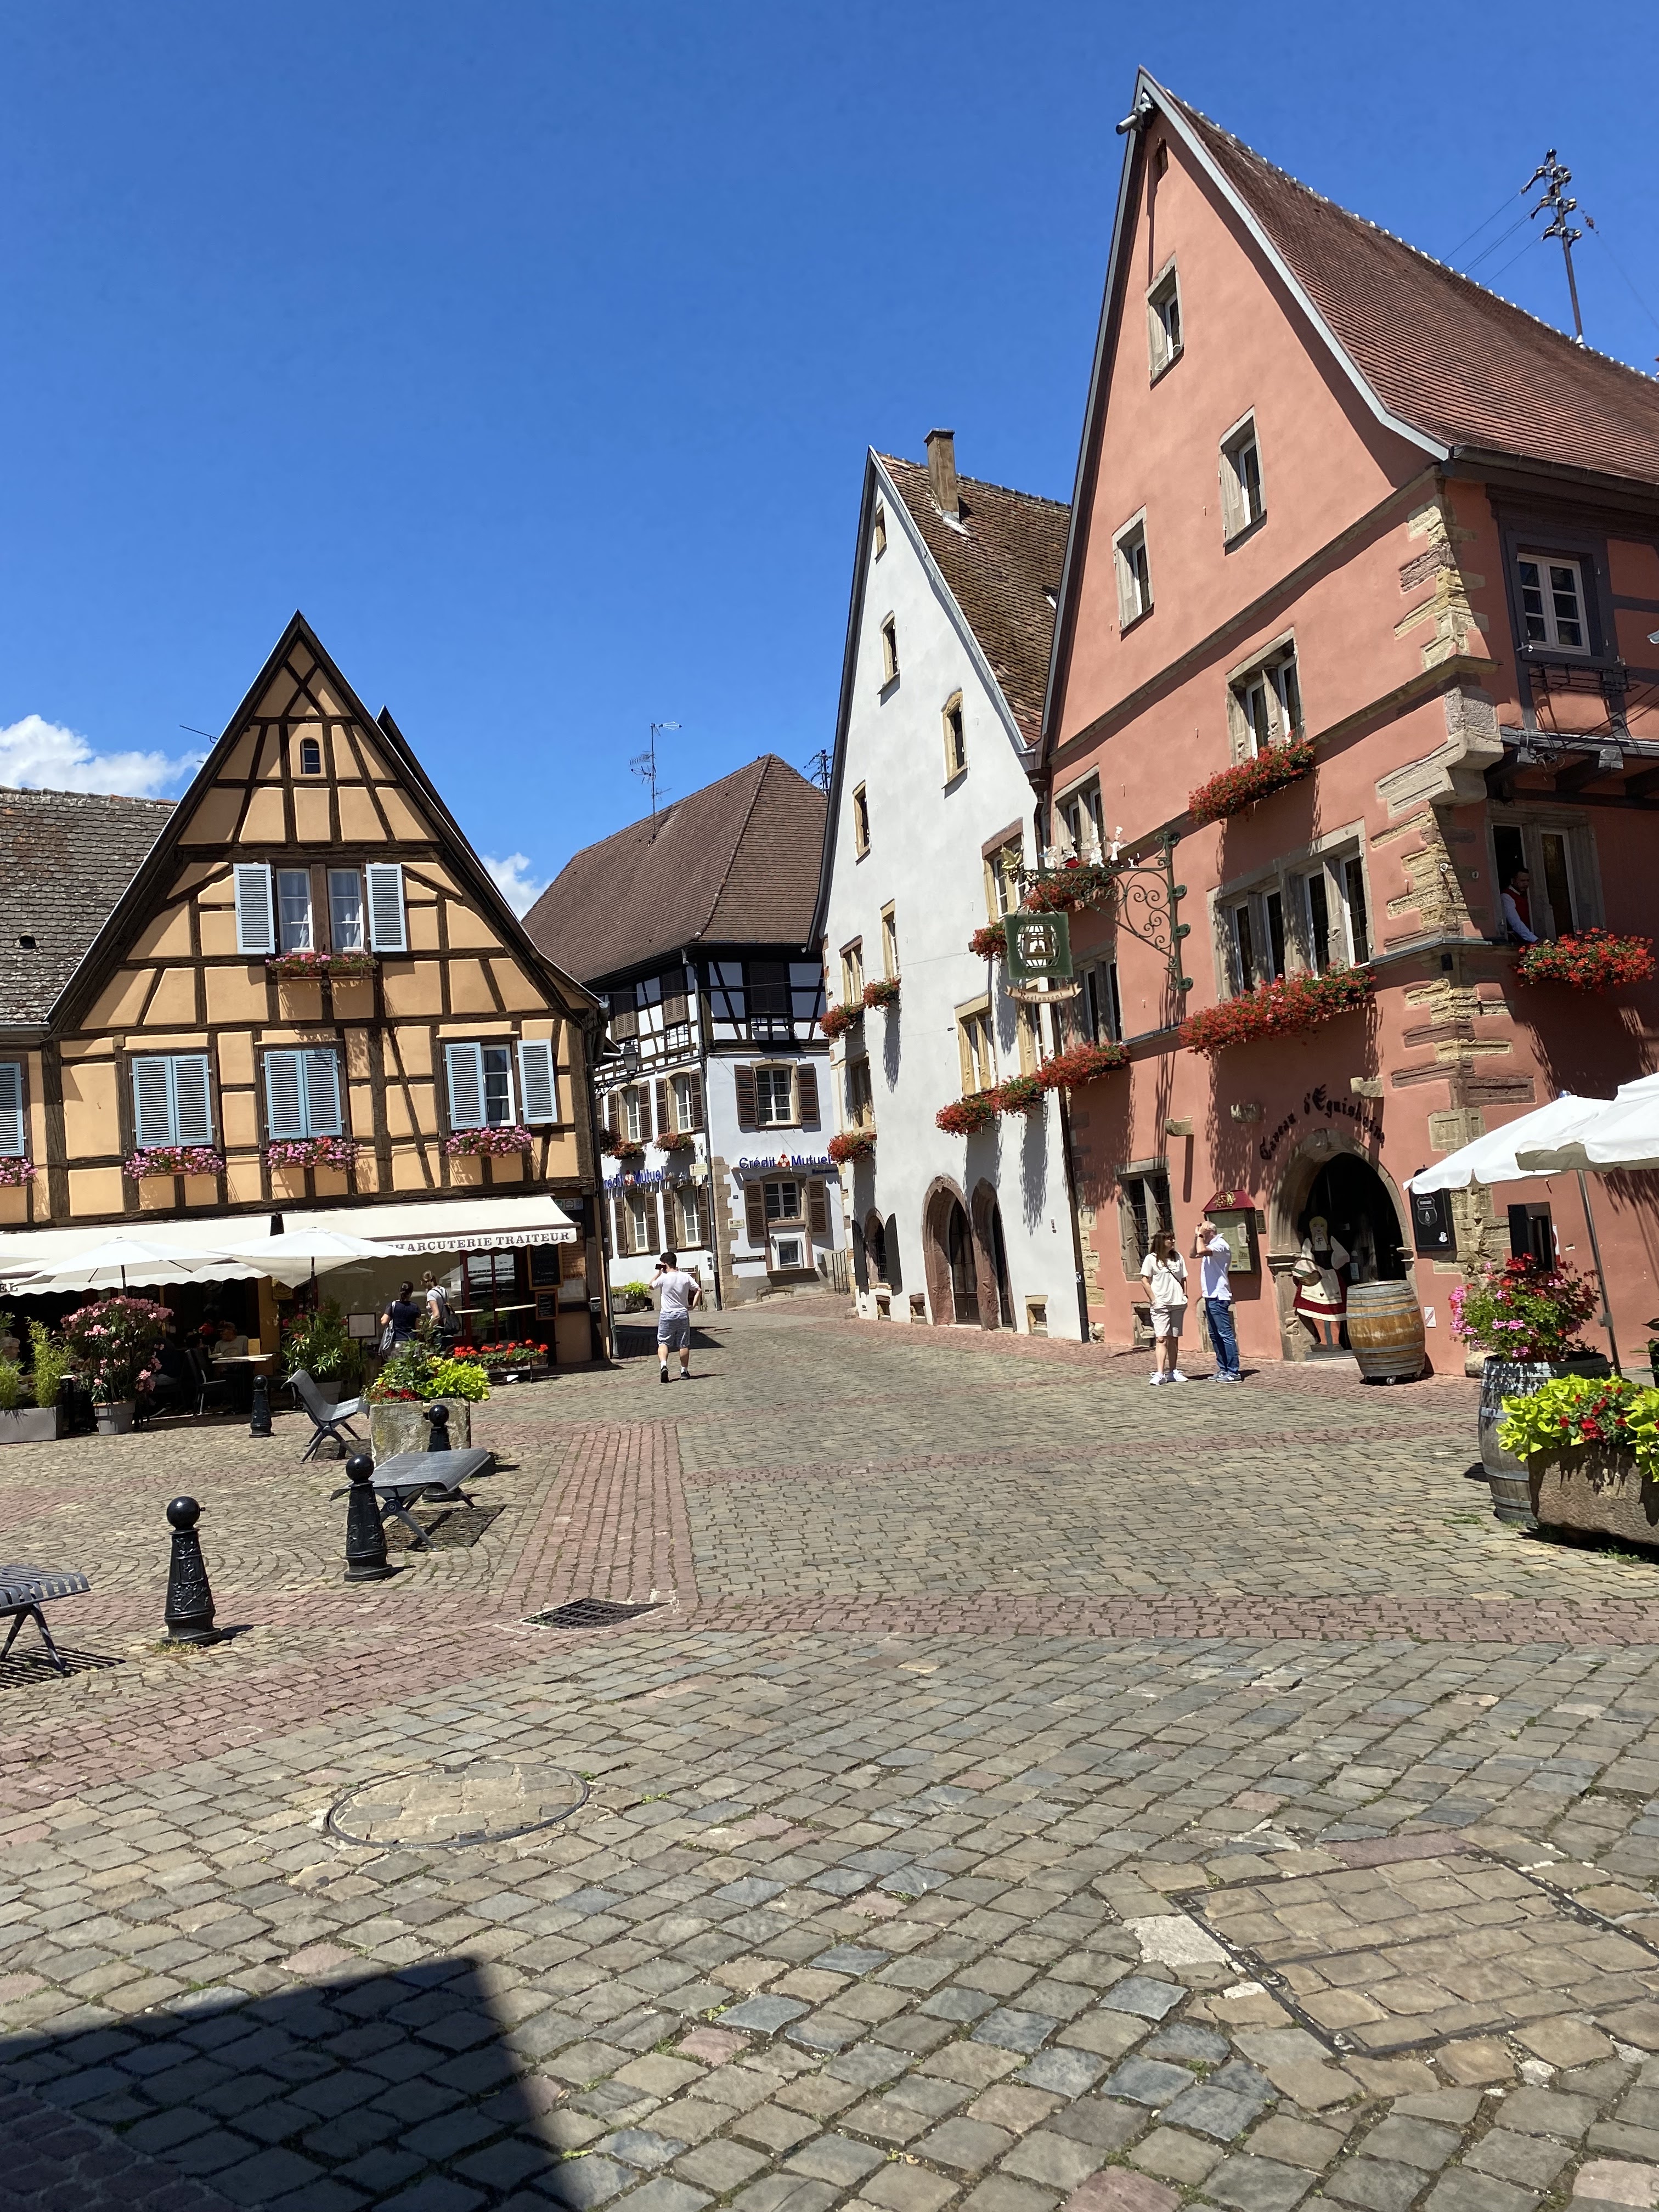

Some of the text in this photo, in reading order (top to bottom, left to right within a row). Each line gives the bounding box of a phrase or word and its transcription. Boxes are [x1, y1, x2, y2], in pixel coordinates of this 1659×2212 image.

[1018, 988, 1064, 1002] Restaurant
[739, 1154, 831, 1169] Crédit Mutuel
[387, 1232, 570, 1251] HARCUTERIE TRAITEUR
